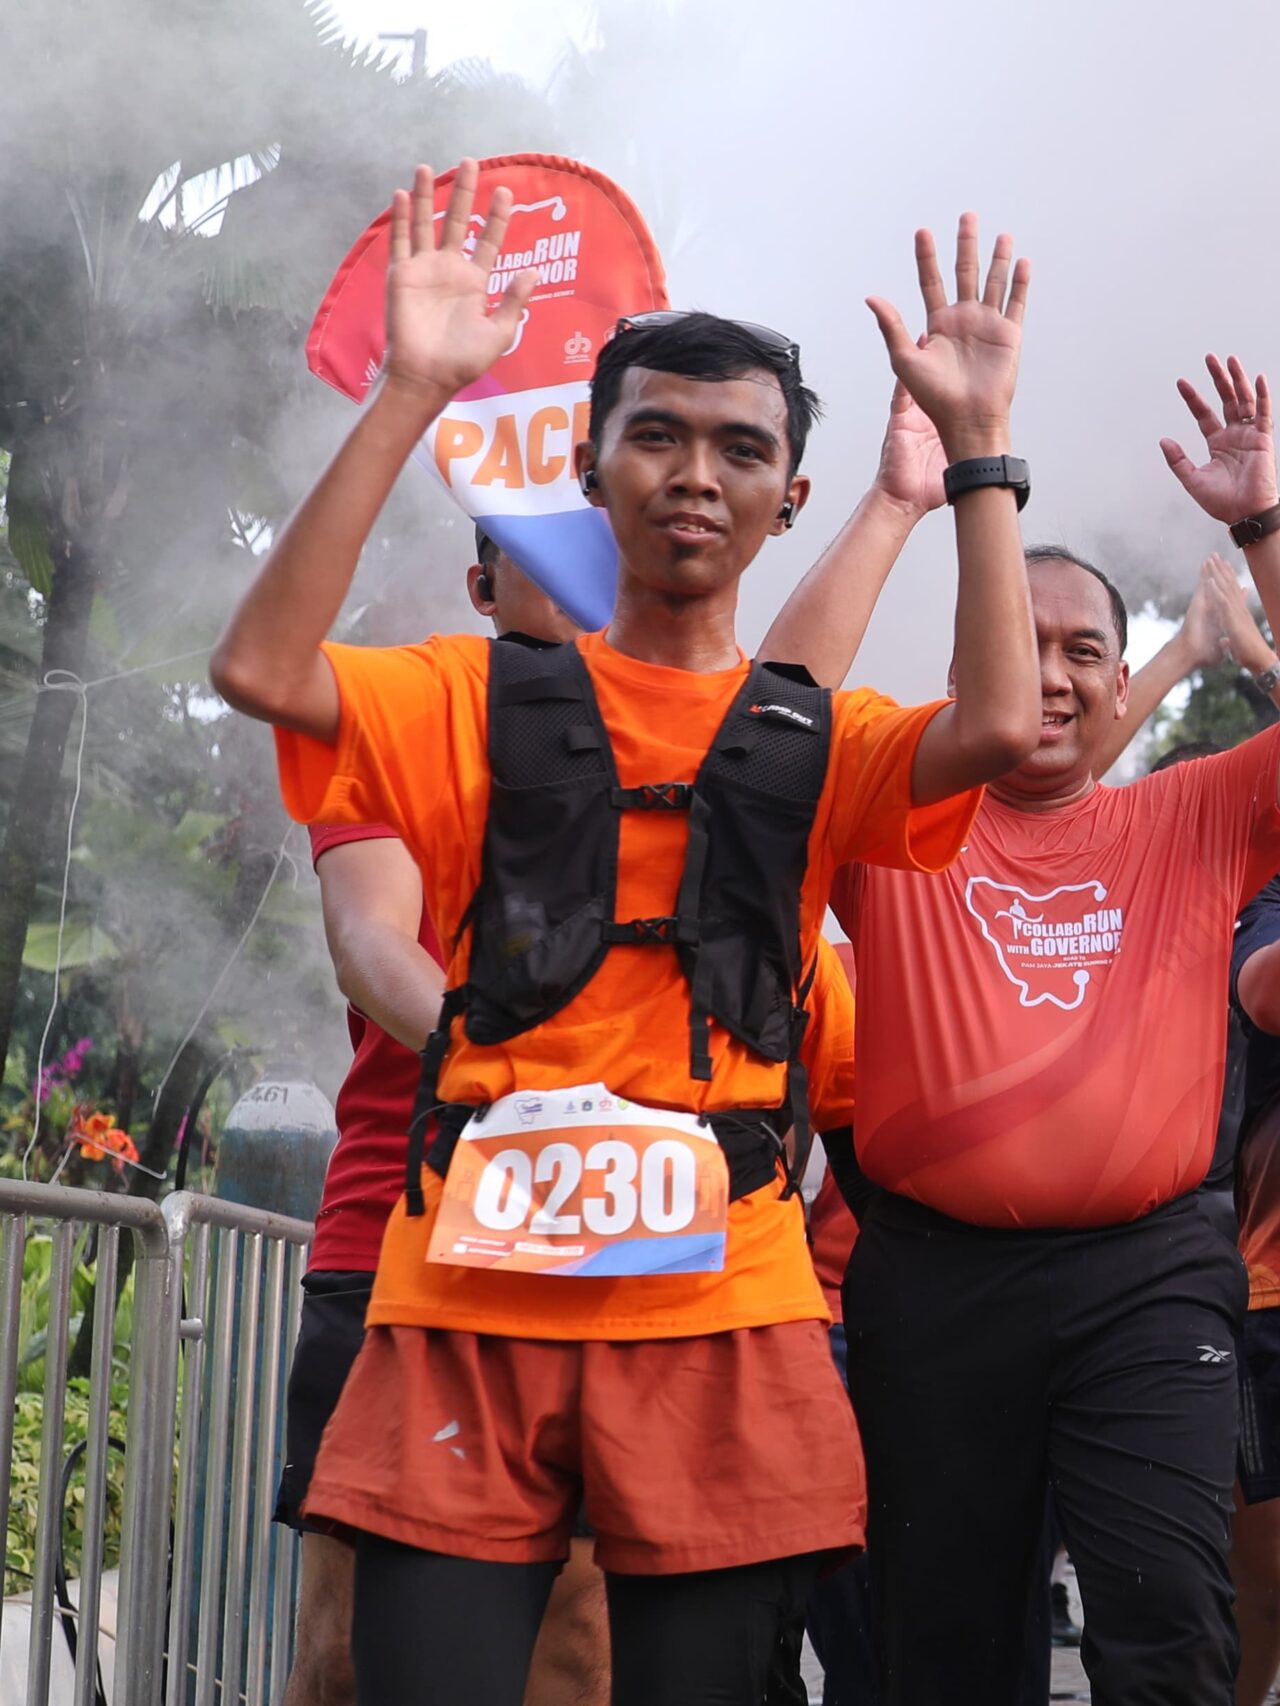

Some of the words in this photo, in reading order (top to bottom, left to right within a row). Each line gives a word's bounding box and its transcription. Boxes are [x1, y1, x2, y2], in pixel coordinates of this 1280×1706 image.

[487, 258, 578, 294] OVNOR
[1022, 908, 1122, 937] COLLABORUN
[1006, 944, 1030, 955] WITH
[1052, 961, 1083, 969] JEKATE
[472, 1139, 696, 1236] 0230
